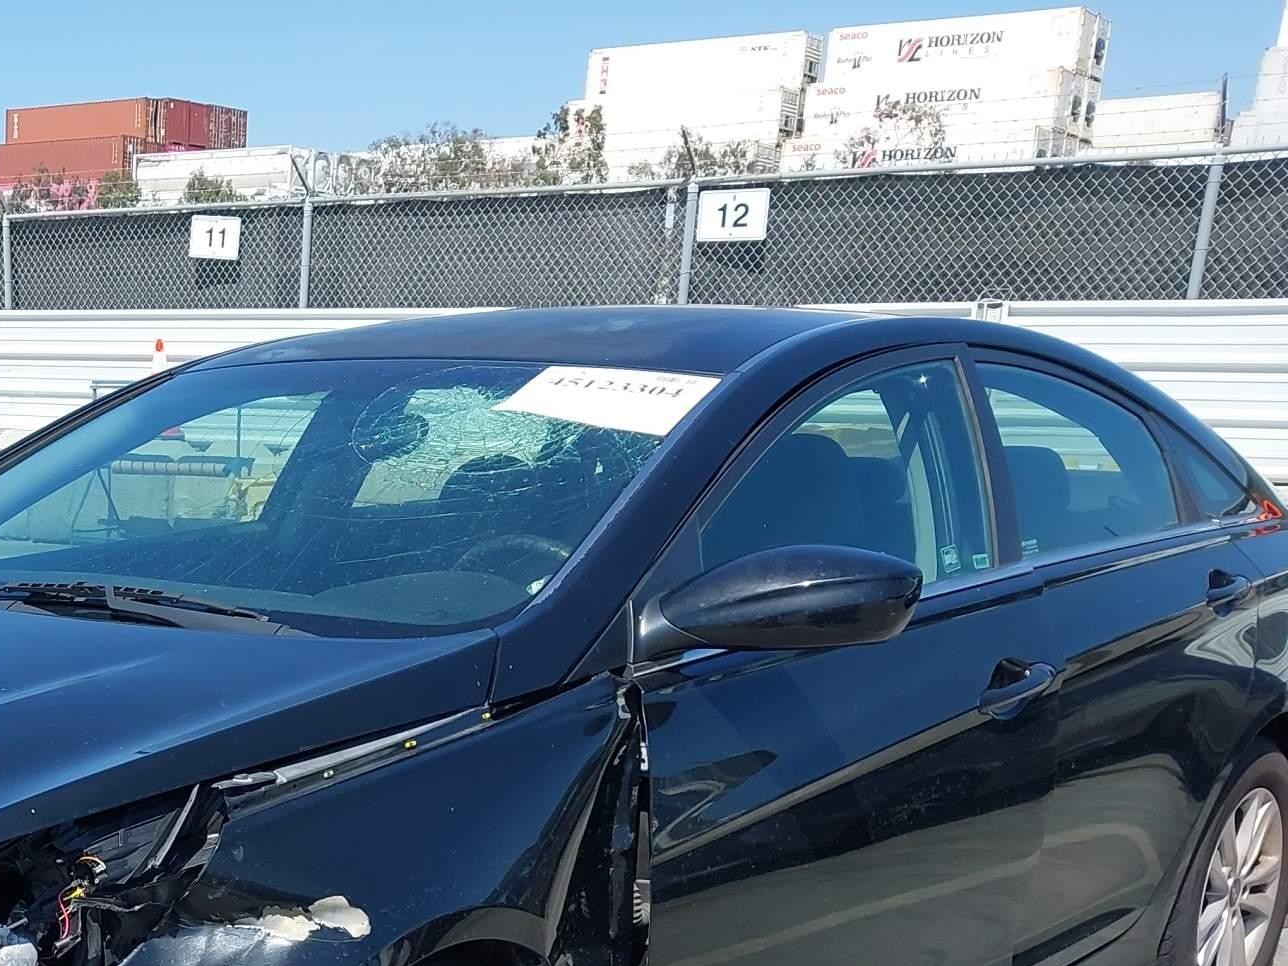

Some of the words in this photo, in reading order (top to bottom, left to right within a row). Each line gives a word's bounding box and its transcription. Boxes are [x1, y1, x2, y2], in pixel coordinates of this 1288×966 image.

[839, 31, 869, 41] seaco
[927, 30, 1005, 48] HORIZON
[816, 86, 846, 96] seaco
[904, 87, 982, 105] HORIZON
[792, 143, 822, 152] seaco
[881, 146, 958, 162] HORIZON
[717, 203, 749, 228] 12
[205, 227, 226, 249] 11
